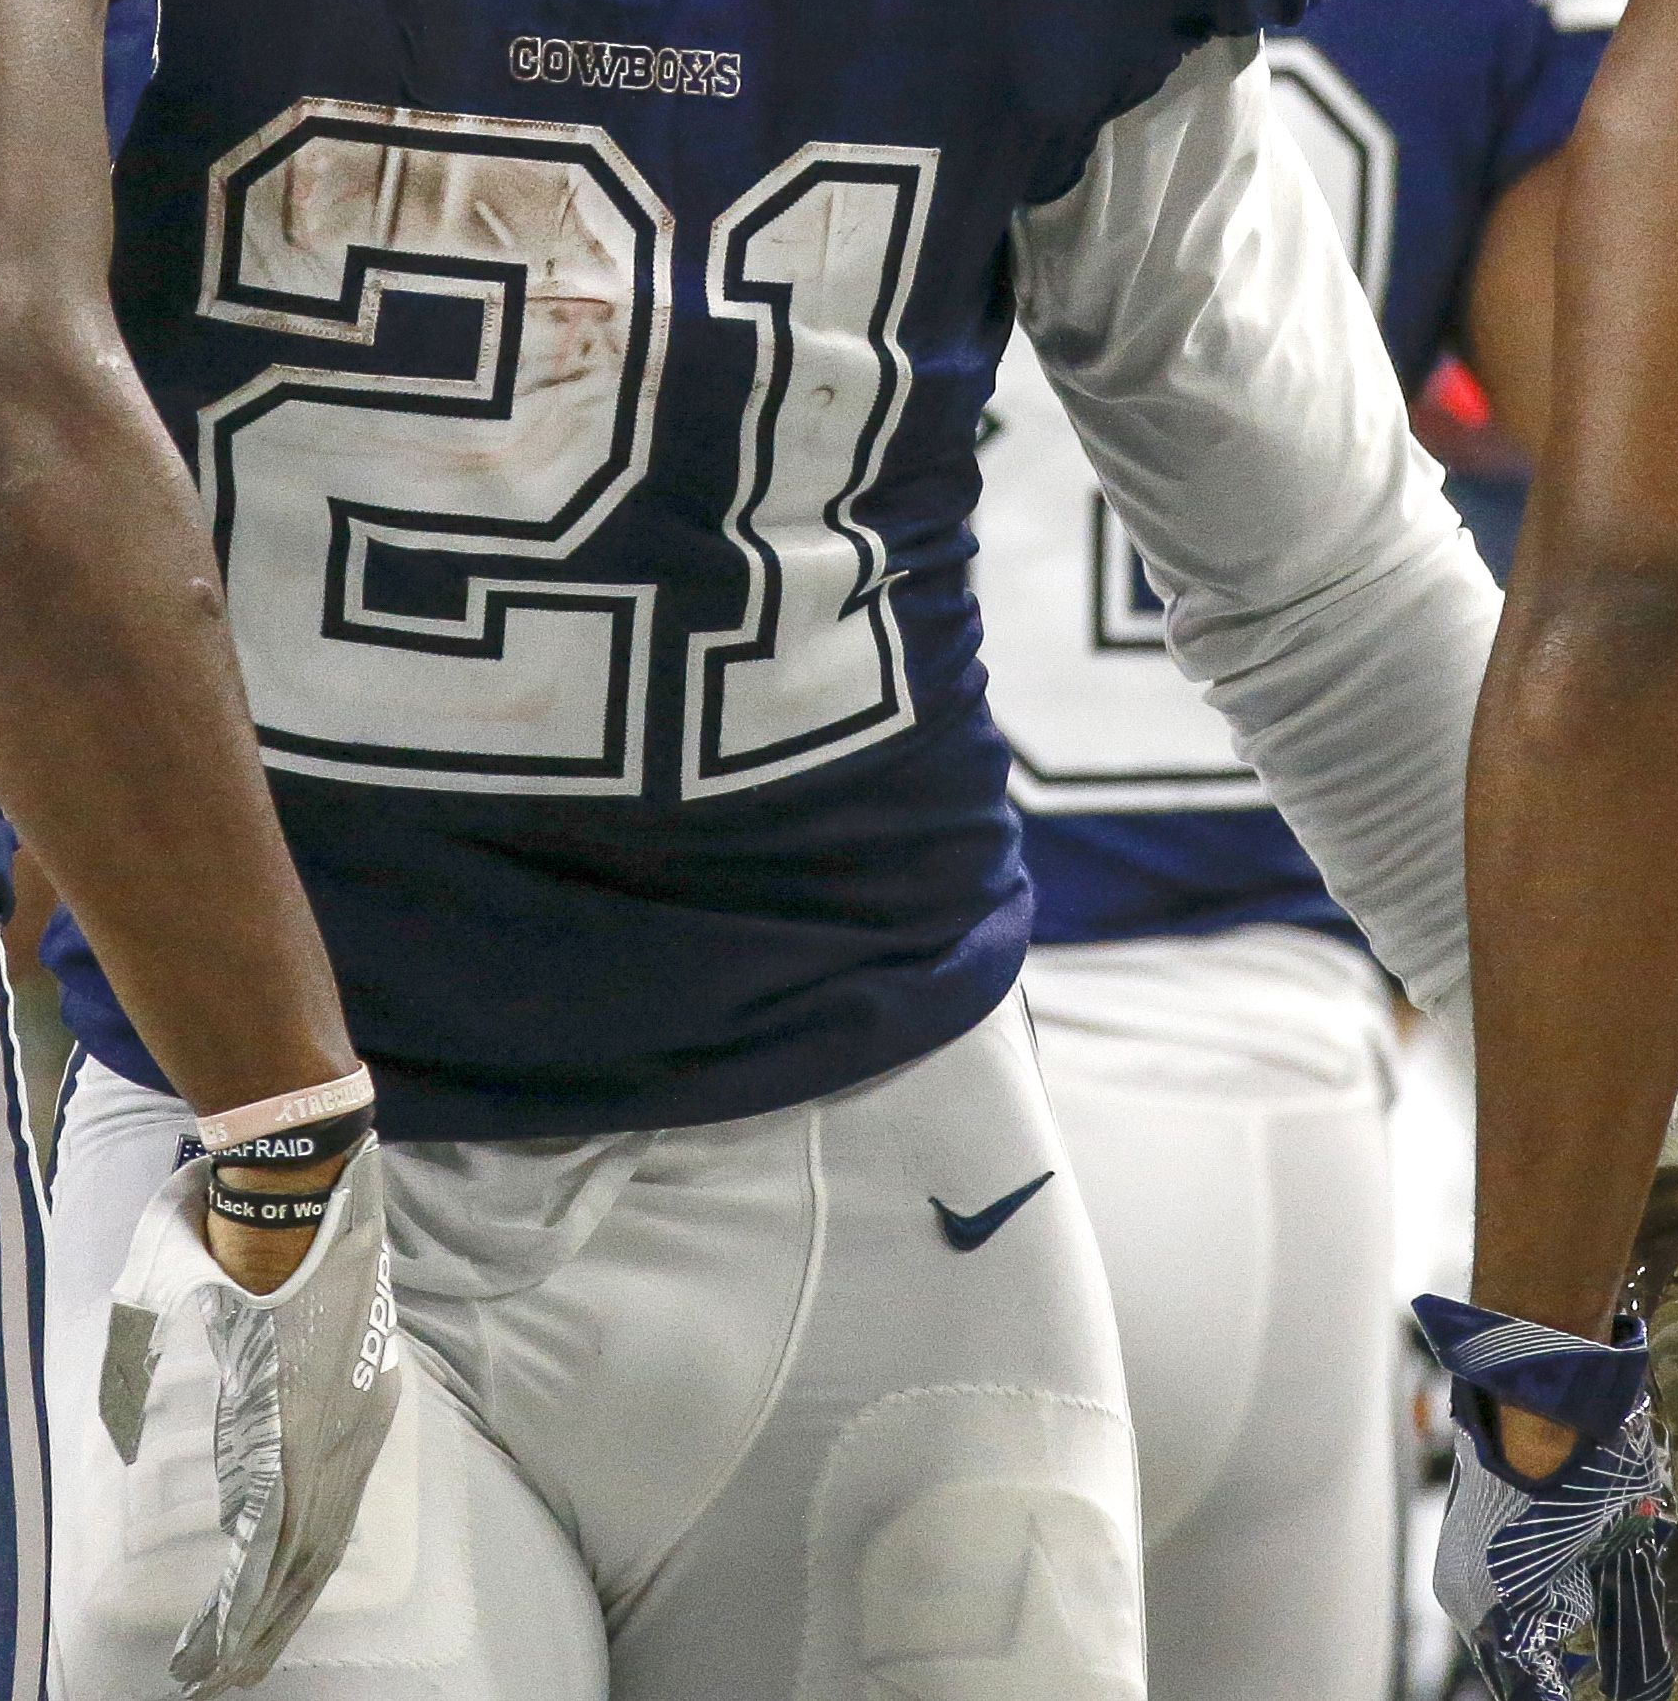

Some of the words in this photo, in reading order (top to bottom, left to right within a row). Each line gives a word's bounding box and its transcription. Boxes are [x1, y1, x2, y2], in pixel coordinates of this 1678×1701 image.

[508, 35, 742, 99] COWBOYS
[195, 94, 941, 803] 21
[216, 1191, 255, 1219] Lack
[260, 1203, 288, 1220] Of
